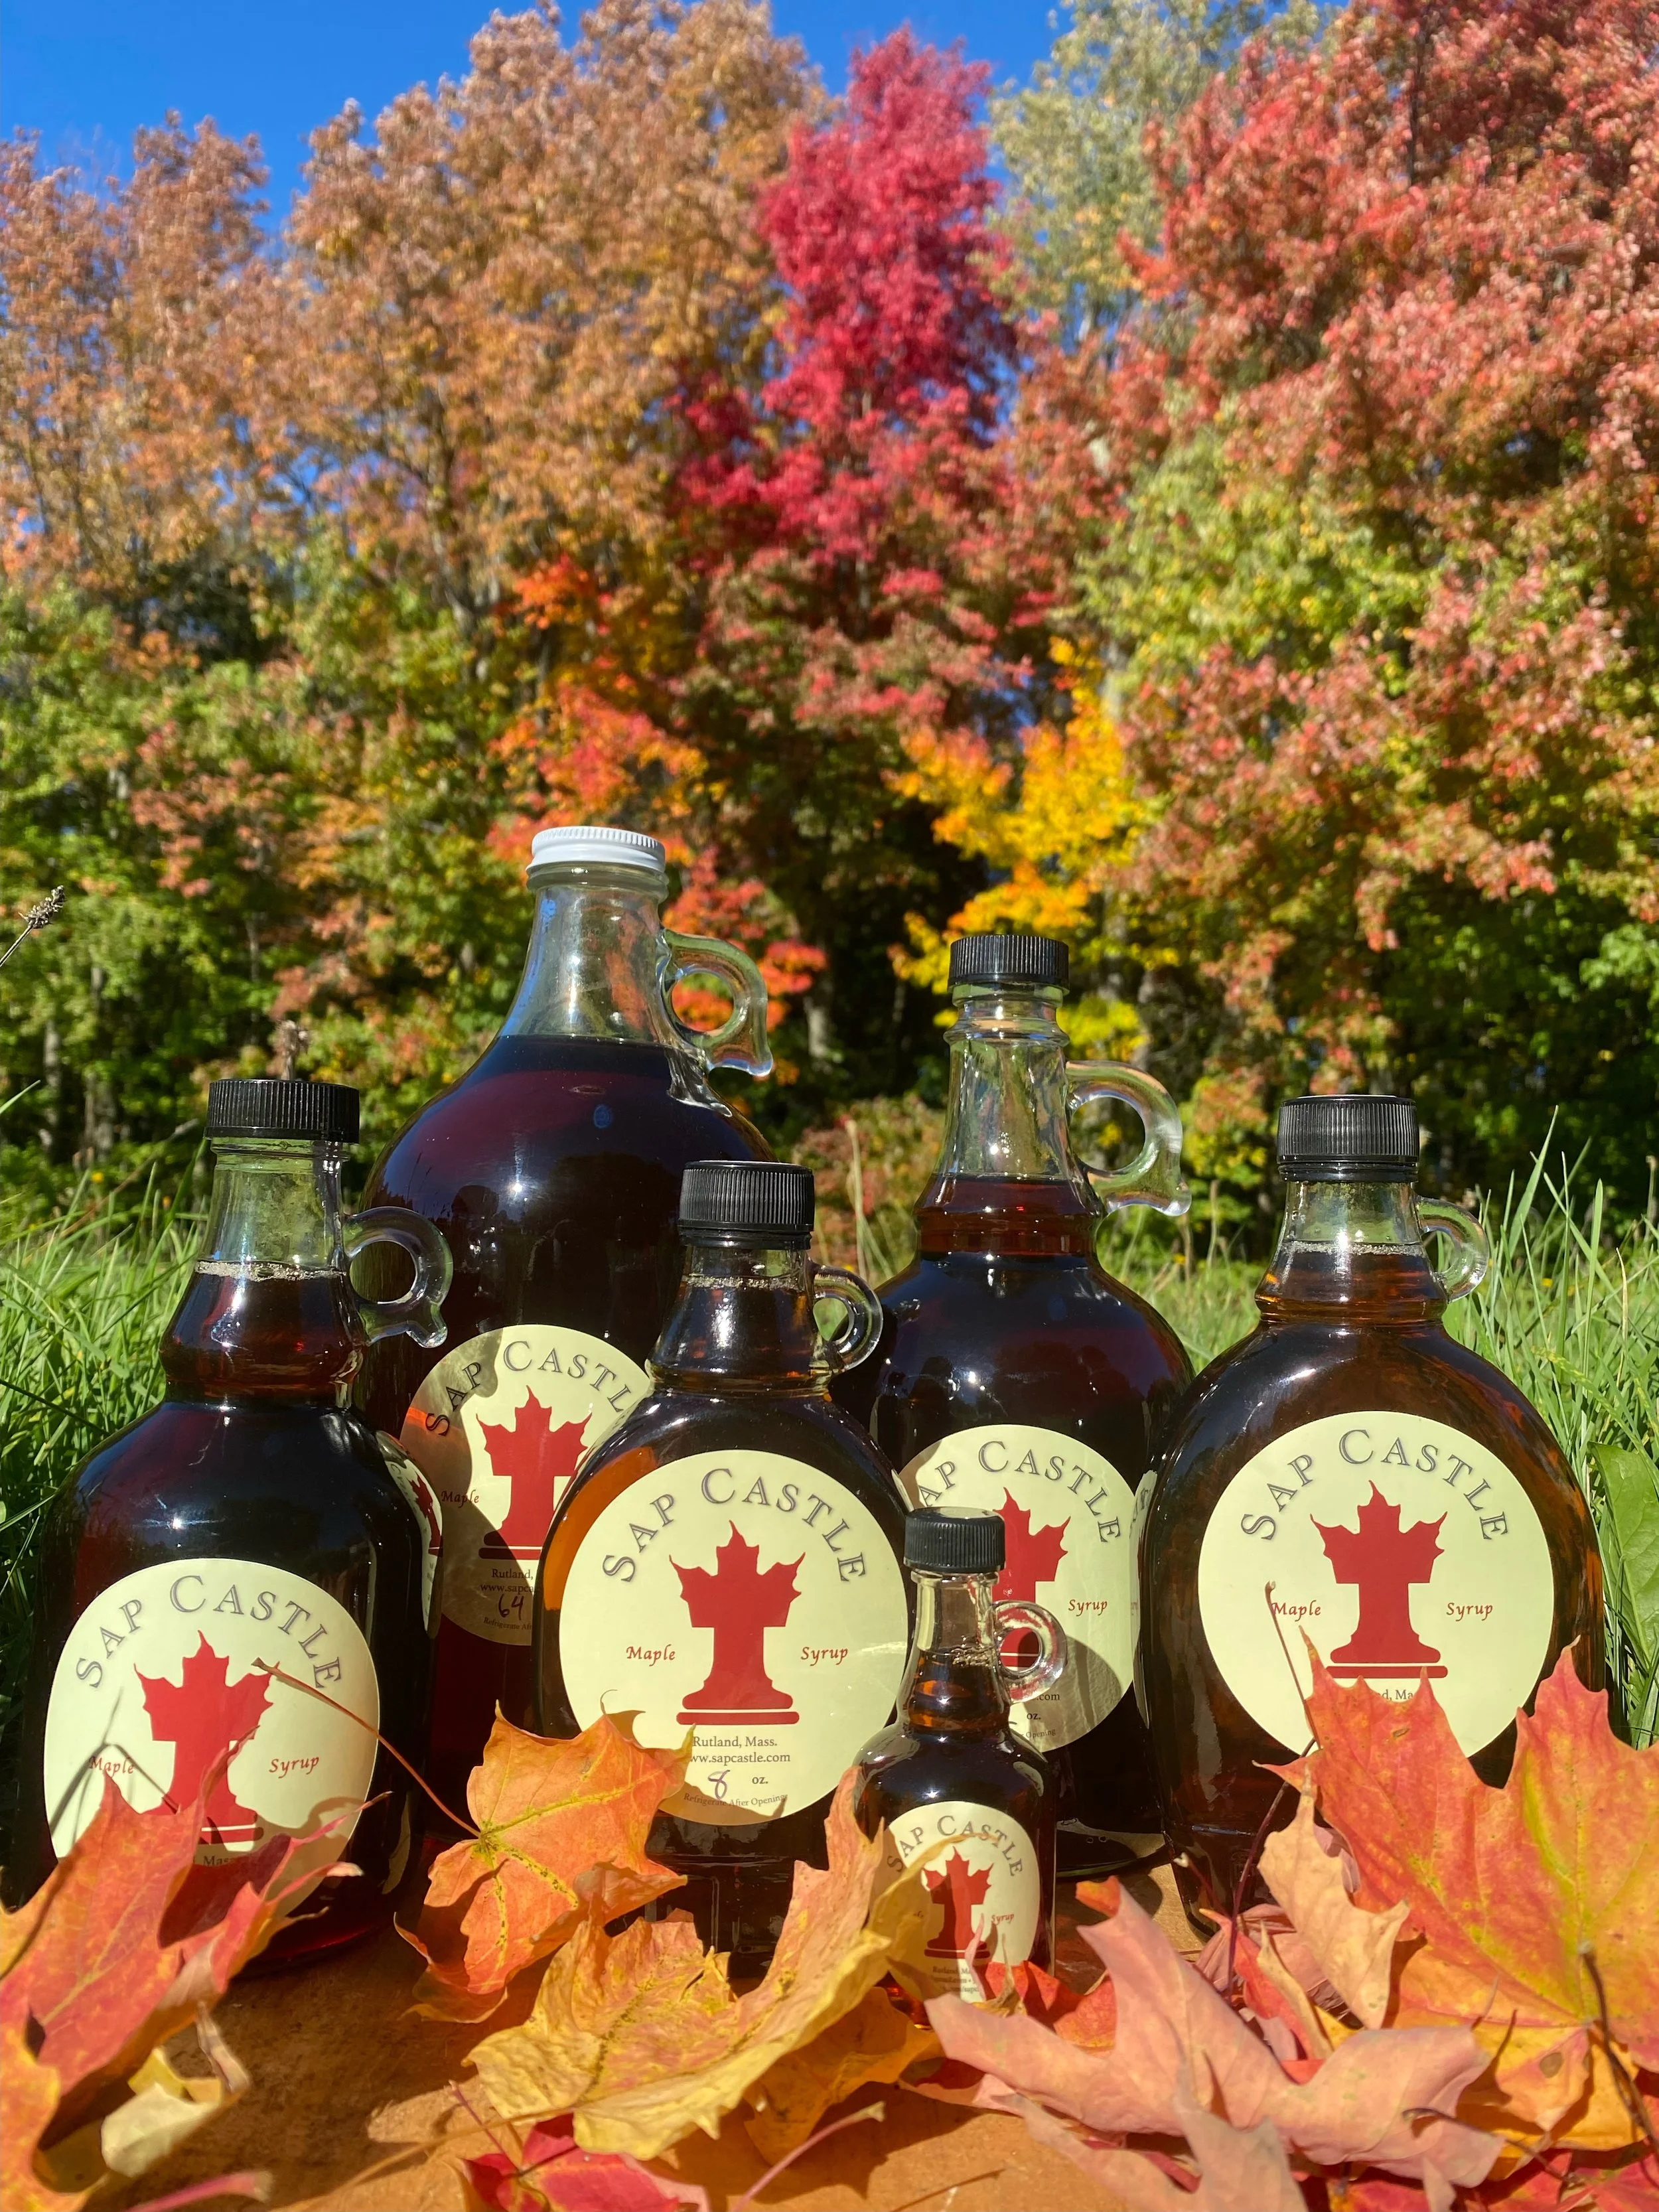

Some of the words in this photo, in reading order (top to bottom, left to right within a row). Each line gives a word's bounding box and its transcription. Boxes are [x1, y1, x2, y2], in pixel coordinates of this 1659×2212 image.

[425, 1362, 482, 1436] SAP
[503, 1341, 631, 1412] CASTL
[918, 1461, 956, 1507] AP
[978, 1440, 1121, 1544] CASTLE
[1241, 1454, 1314, 1540] SAP
[1338, 1429, 1510, 1540] CASTLE
[440, 1489, 480, 1505] Maple
[601, 1493, 677, 1583] SAP
[700, 1467, 867, 1583] CASTLE
[491, 1568, 534, 1580] Rutland,
[480, 1584, 535, 1595] www.sapca
[498, 1593, 524, 1621] 64
[1068, 1598, 1108, 1616] Syrup
[1271, 1599, 1322, 1621] Maple
[1446, 1602, 1494, 1621] Syrup
[76, 1599, 143, 1689] SAP
[169, 1574, 342, 1689] CASTLE
[626, 1644, 676, 1666] Maple
[800, 1645, 849, 1666] Syrup
[693, 1736, 742, 1748] Rutland,
[745, 1736, 778, 1747] Mass.
[1025, 1728, 1056, 1739] Opening
[89, 1756, 135, 1779] Maple
[269, 1755, 321, 1779] Syrup
[690, 1752, 791, 1767] ww.sapcastle.com
[707, 1769, 731, 1800] 8
[751, 1776, 768, 1785] oz.
[684, 1793, 728, 1806] Refrigerate
[751, 1794, 788, 1807] Opening
[887, 1826, 924, 1873] SAP
[937, 1815, 1023, 1877] CASTLE
[991, 1913, 1015, 1925] Syrup
